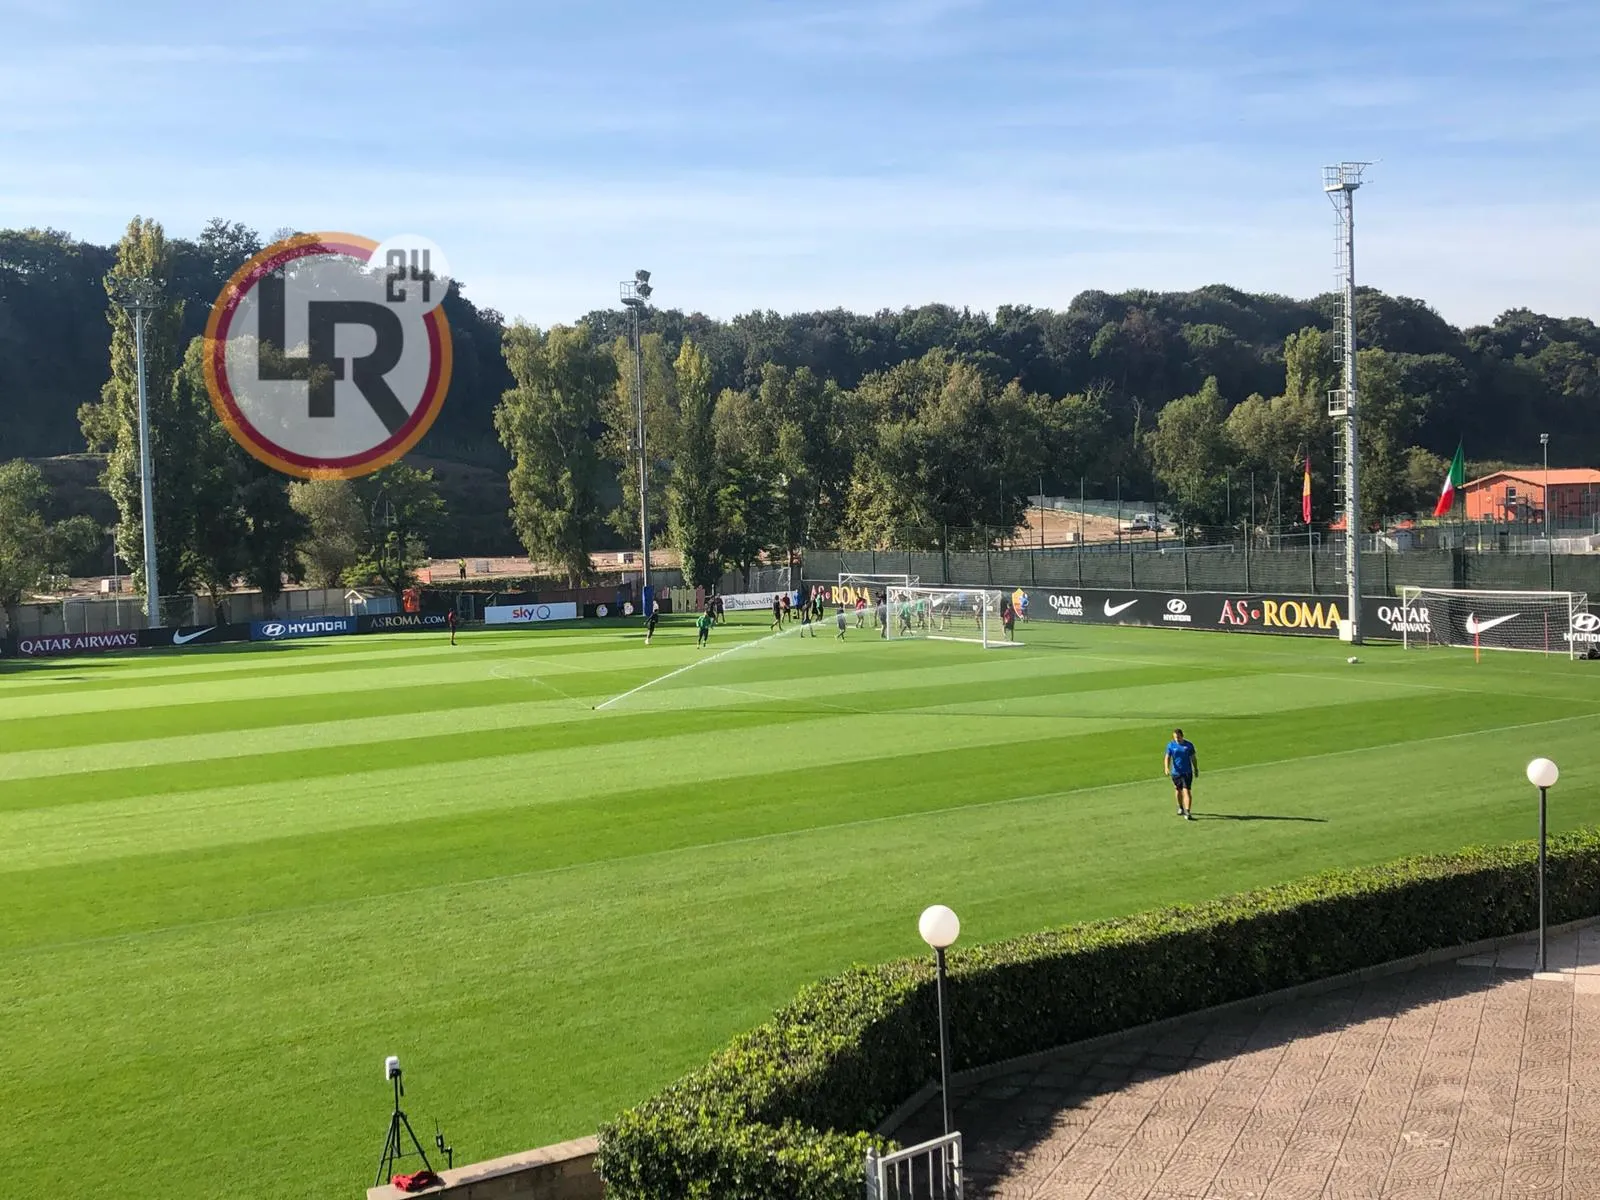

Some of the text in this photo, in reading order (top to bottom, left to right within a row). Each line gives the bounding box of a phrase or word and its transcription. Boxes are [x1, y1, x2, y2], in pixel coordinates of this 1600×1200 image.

[1049, 595, 1083, 609] QATAR
[512, 607, 535, 620] sky
[1218, 600, 1343, 629] AS ROMA
[1377, 606, 1431, 624] QATAR
[288, 620, 347, 634] HYUNDAI
[370, 615, 446, 628] ASROMA.COM
[1391, 622, 1431, 633] AIRWAYS
[20, 633, 137, 654] QATAR AIRWAYS
[1563, 632, 1600, 642] HYUND
